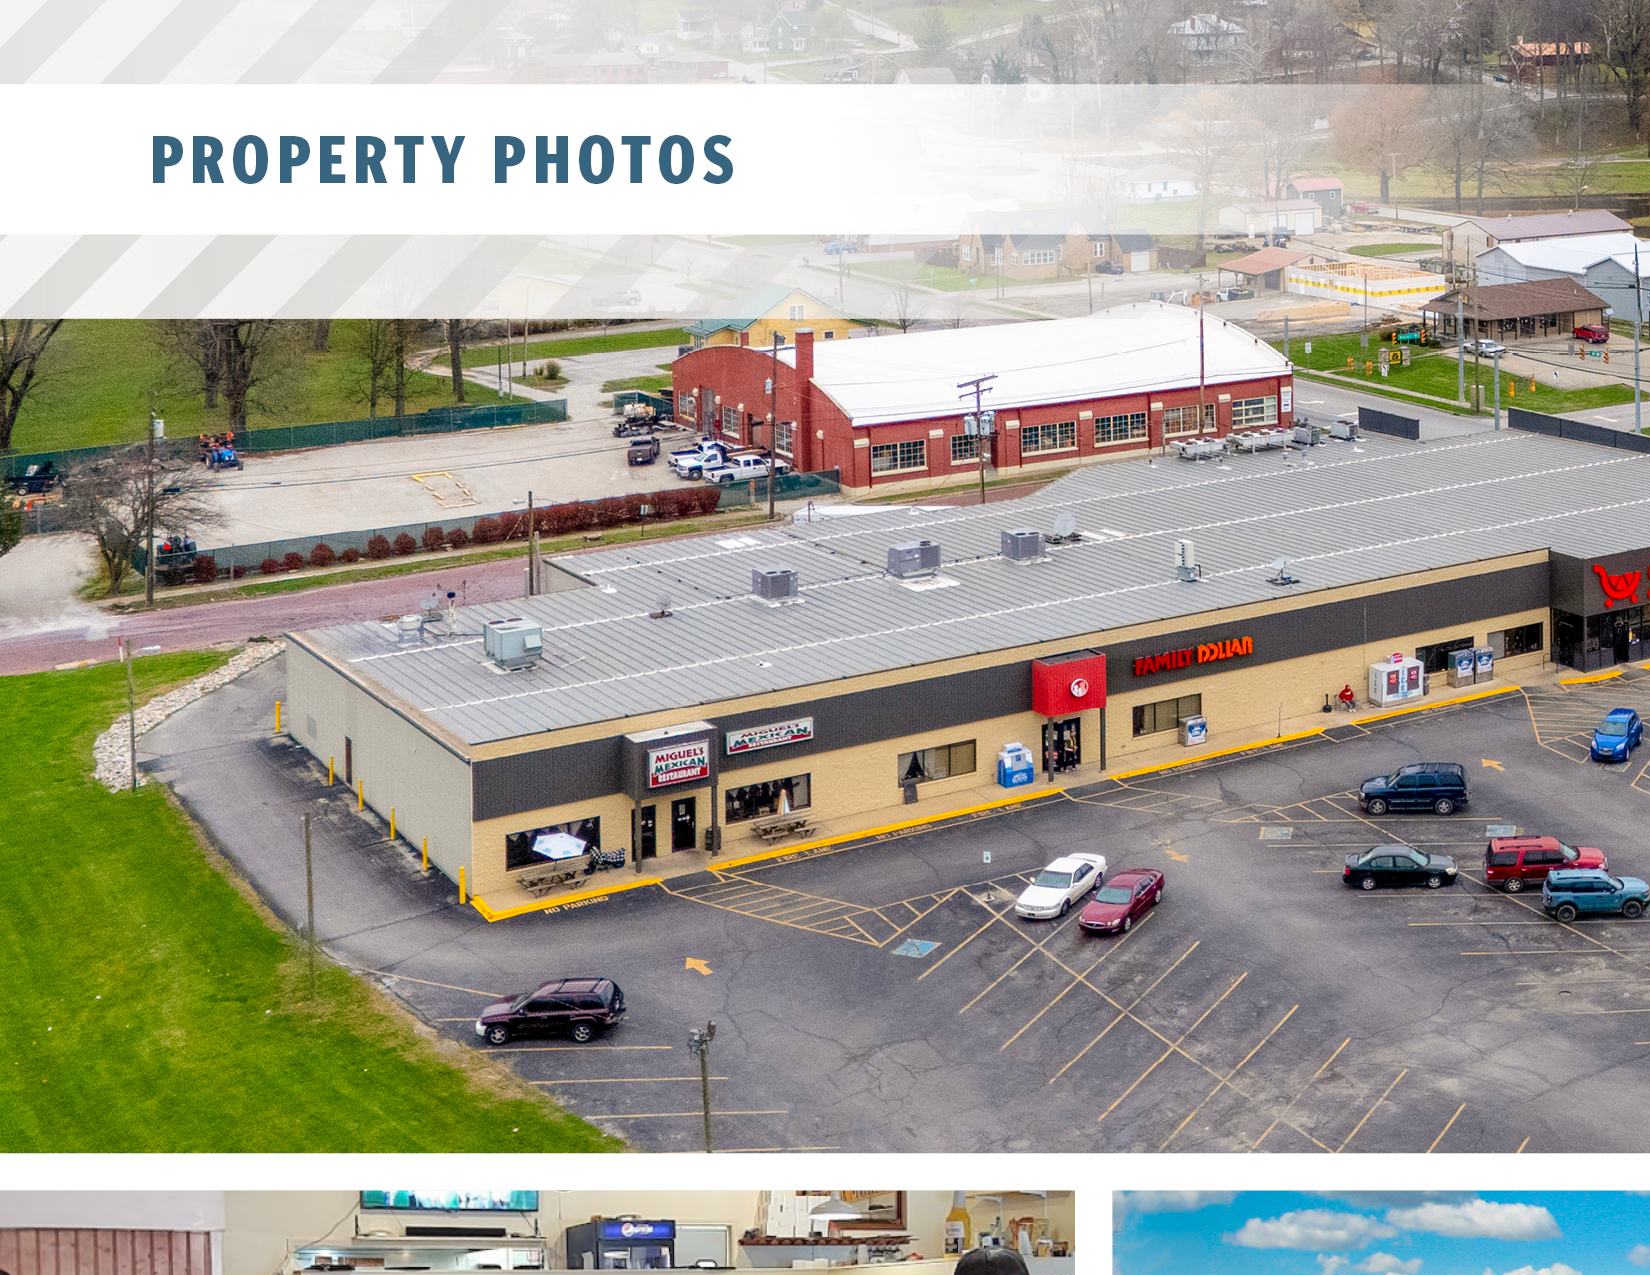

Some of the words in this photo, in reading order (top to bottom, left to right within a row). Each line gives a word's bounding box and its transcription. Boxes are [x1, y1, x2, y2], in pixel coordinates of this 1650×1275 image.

[1134, 648, 1192, 676] FAMILY
[1197, 636, 1253, 664] DOLLAR
[734, 727, 807, 748] MEXICAN
[655, 747, 704, 764] MIGUEL'S
[654, 756, 706, 775] MEXICAN
[658, 767, 702, 783] RESTAURANT
[875, 832, 893, 842] NO
[897, 823, 932, 837] PARKING
[776, 852, 800, 863] FIRE
[805, 845, 834, 858] LANE
[543, 906, 561, 915] NO
[563, 895, 609, 911] PARKING
